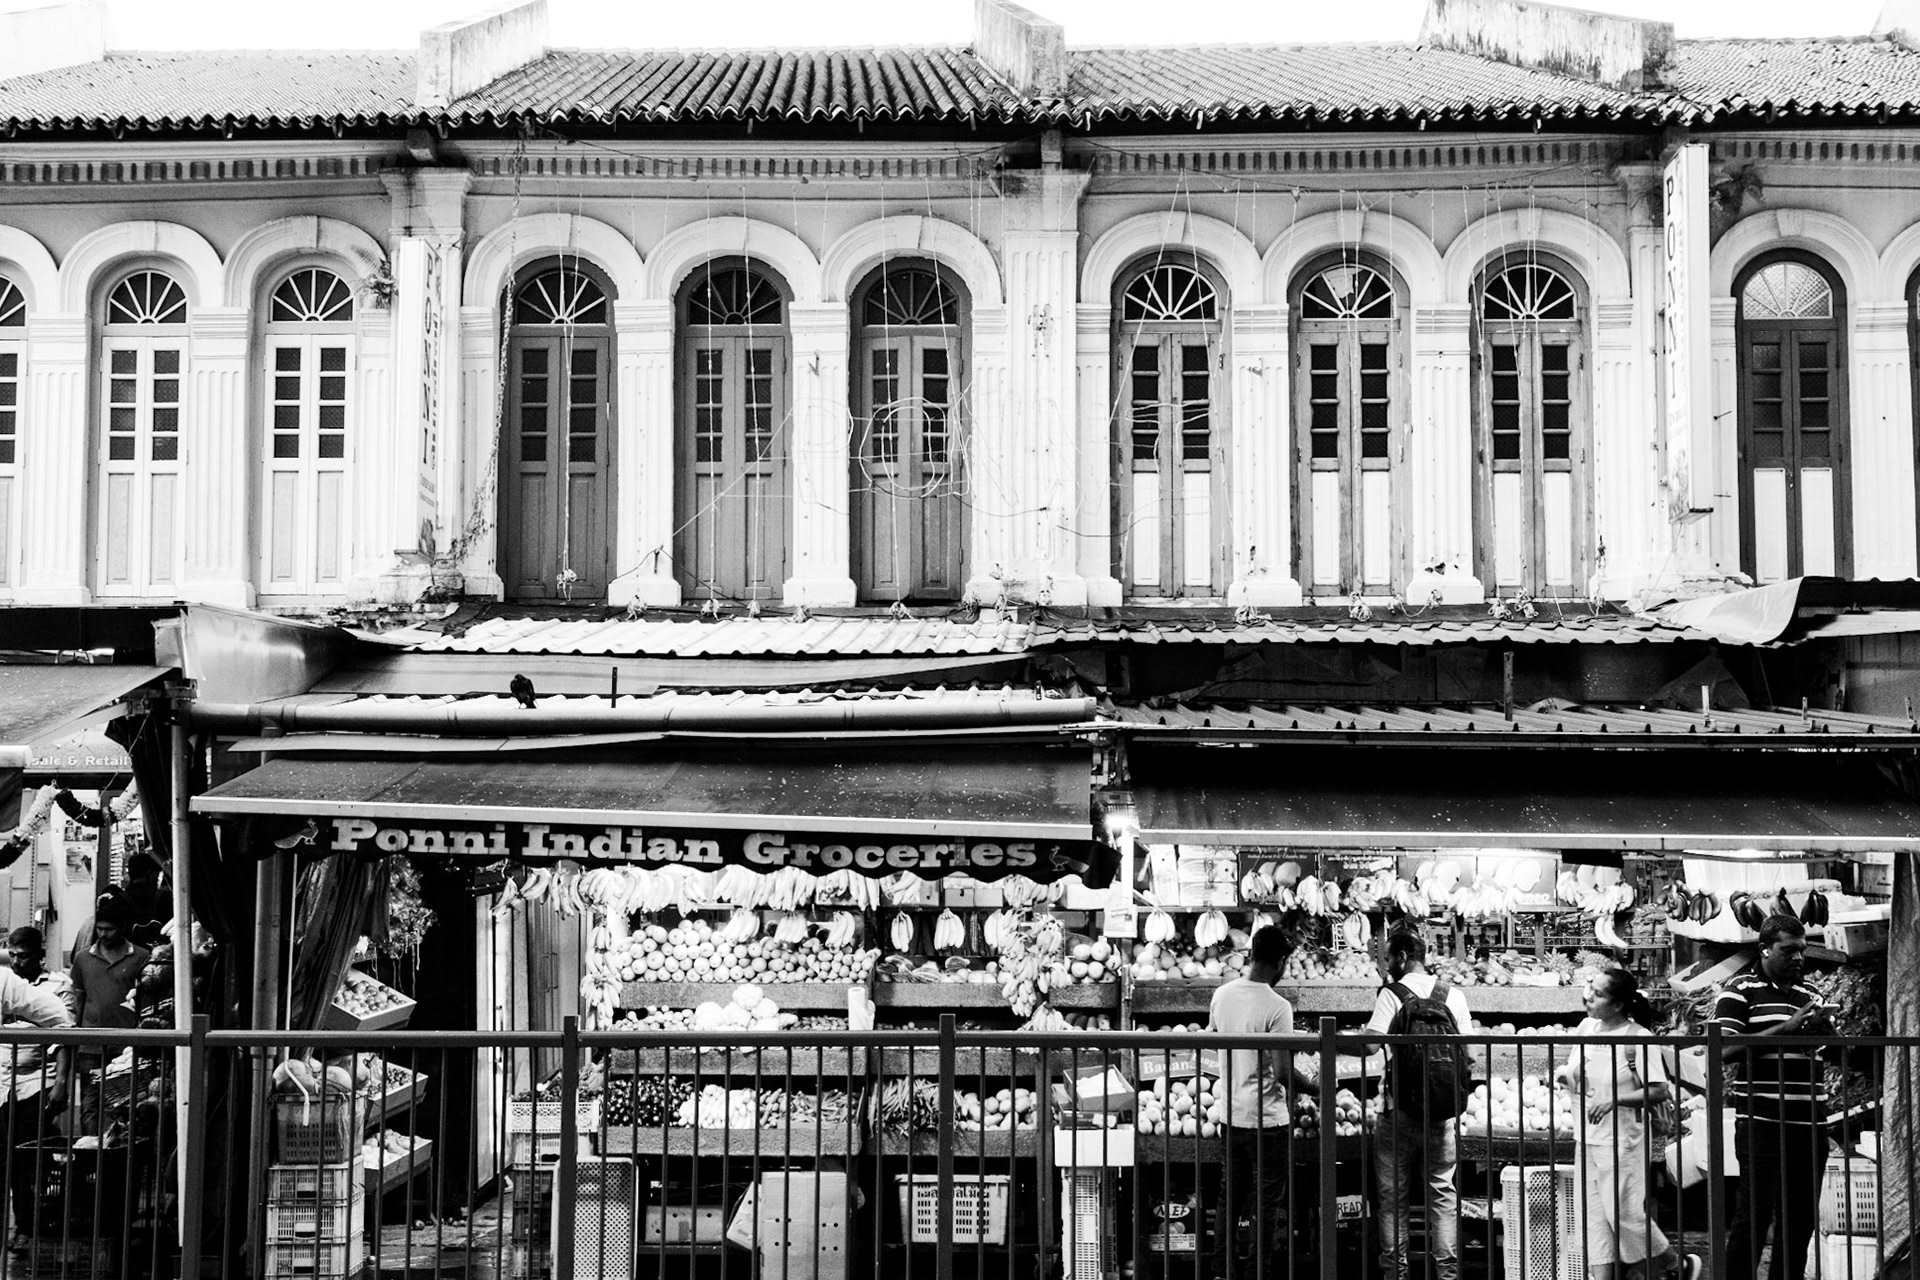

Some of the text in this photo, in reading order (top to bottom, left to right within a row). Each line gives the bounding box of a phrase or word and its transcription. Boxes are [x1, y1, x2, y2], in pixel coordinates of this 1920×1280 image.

[1666, 175, 1677, 399] PONNI
[423, 252, 433, 465] PONNI
[31, 755, 61, 766] sale
[85, 755, 128, 766] Retail
[331, 818, 1037, 869] Ponni Indian Groceries
